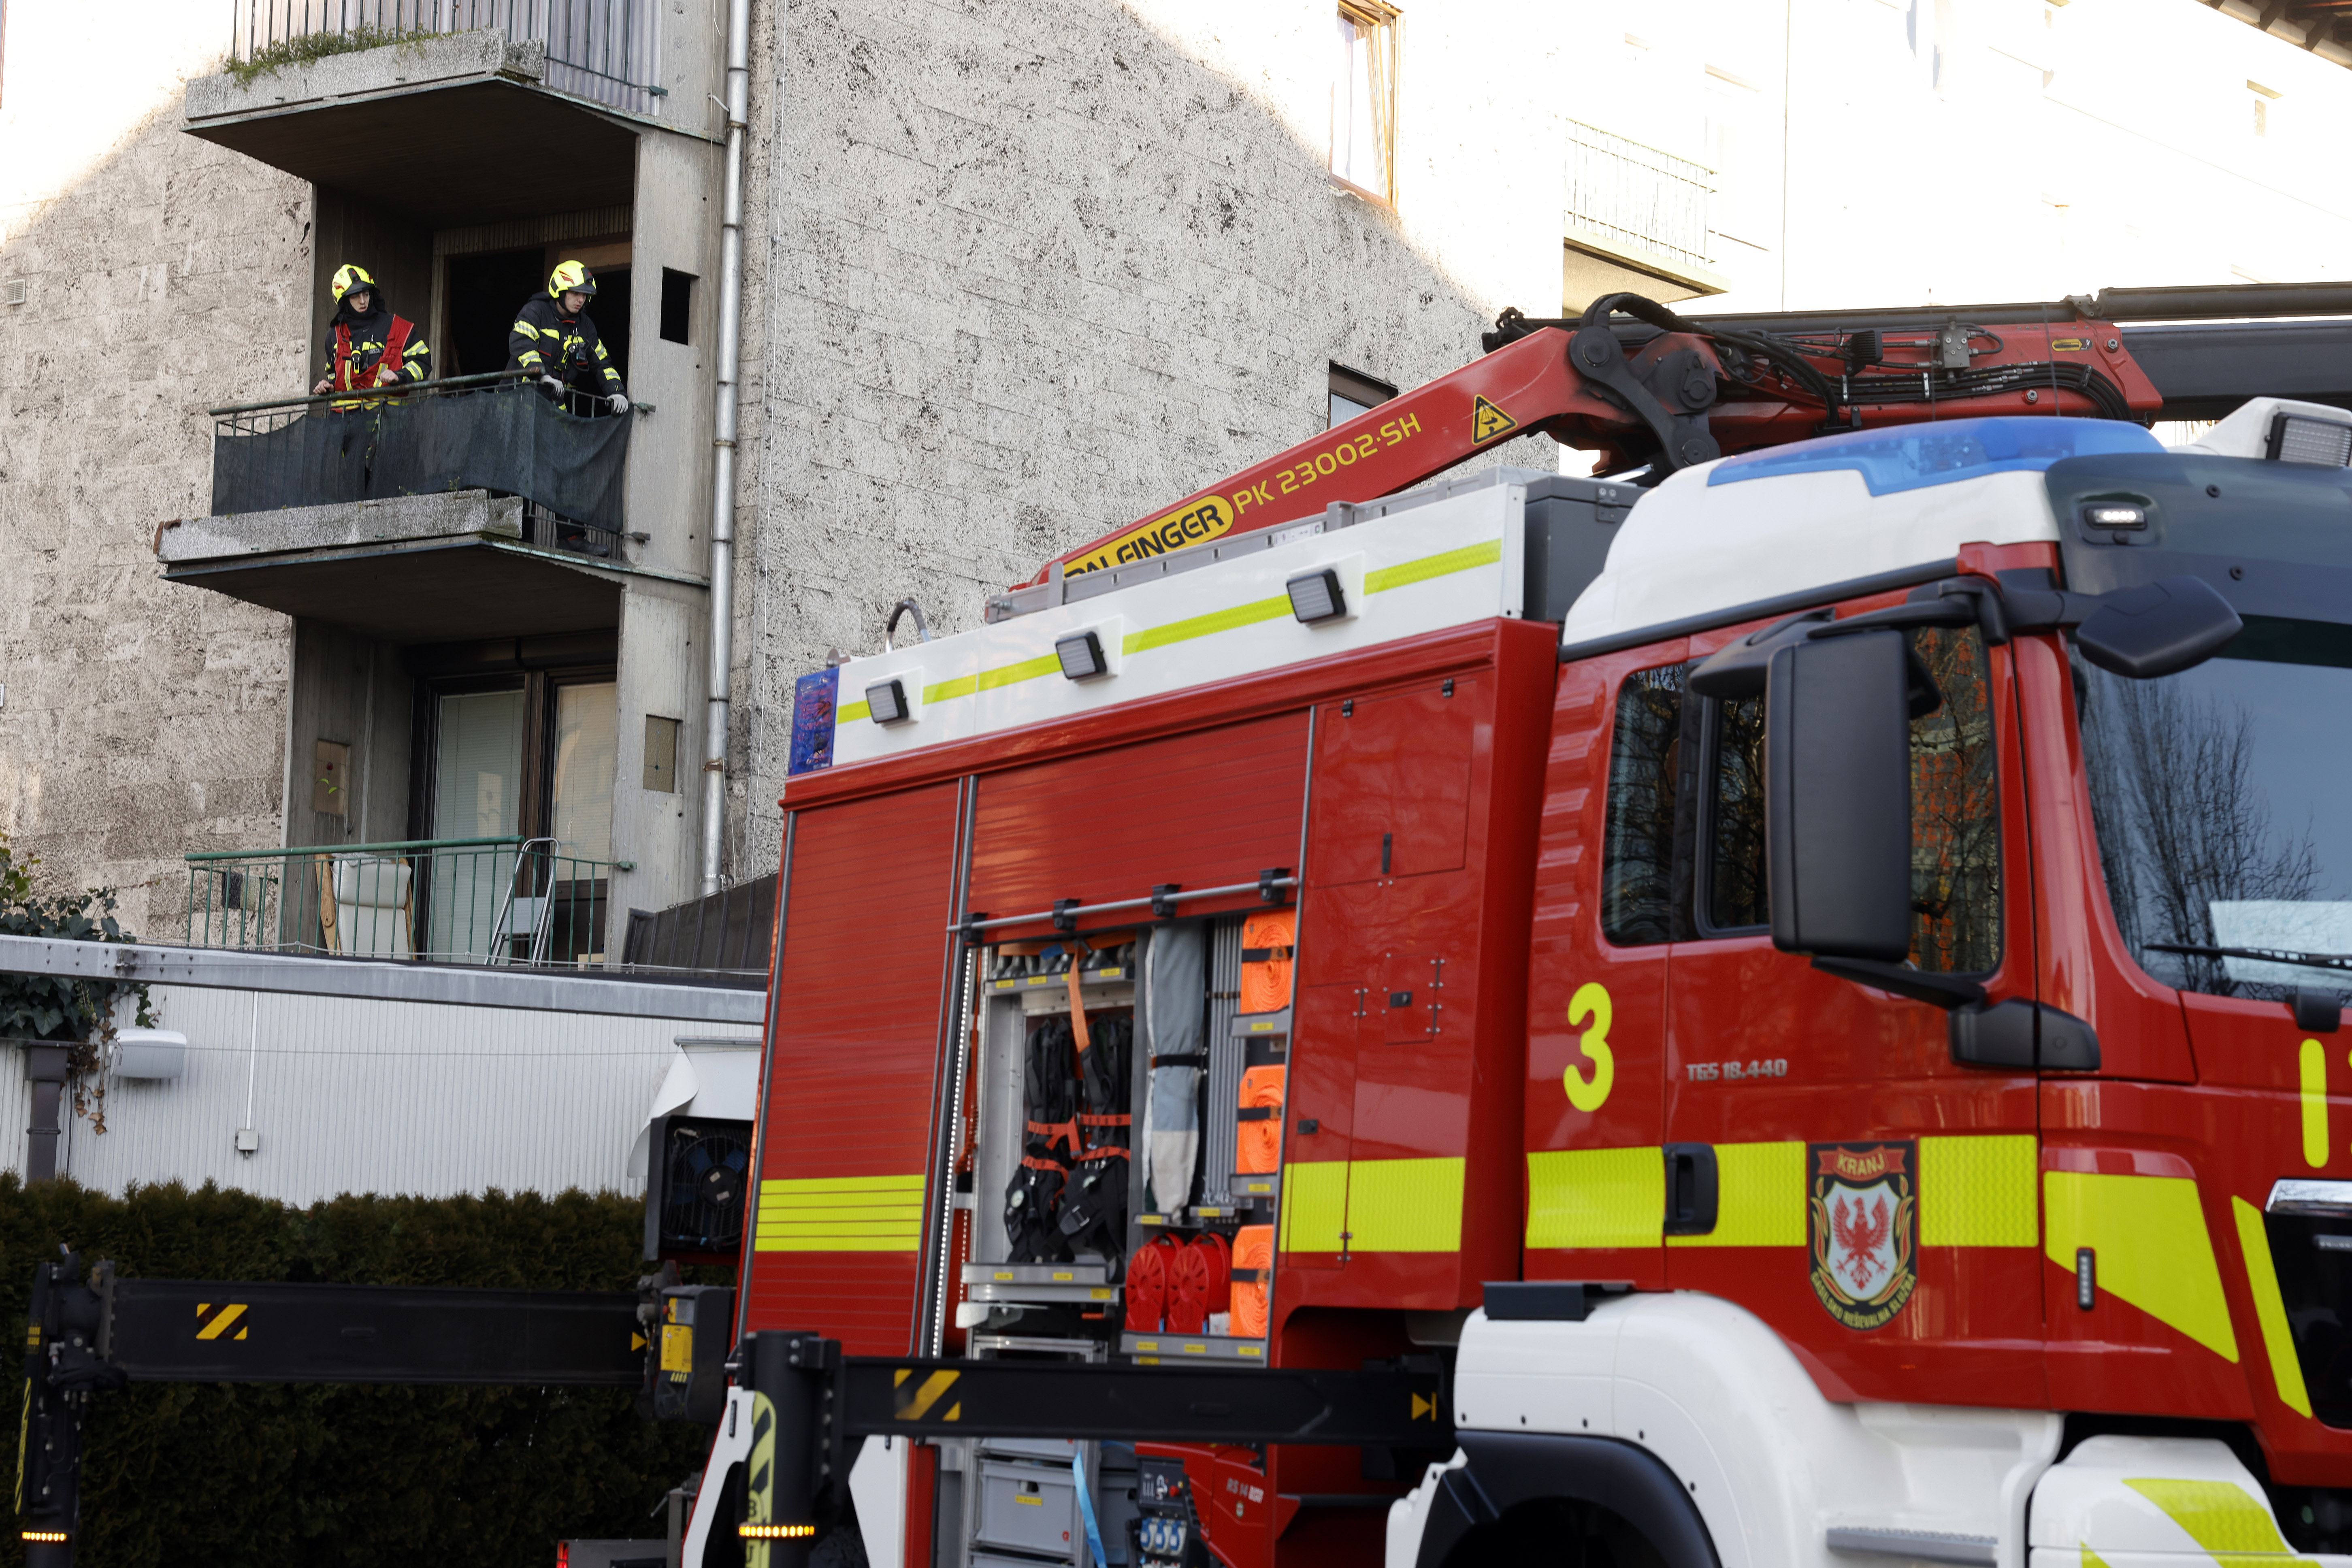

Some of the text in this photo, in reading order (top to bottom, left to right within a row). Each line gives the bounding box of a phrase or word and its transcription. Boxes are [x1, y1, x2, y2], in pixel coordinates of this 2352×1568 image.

[1065, 505, 1225, 578] FINGER
[1232, 479, 1275, 514] PK
[1563, 982, 1615, 1112] 3
[1686, 1058, 1787, 1082] TGS 18.440
[1837, 1152, 1885, 1176] KRANJ
